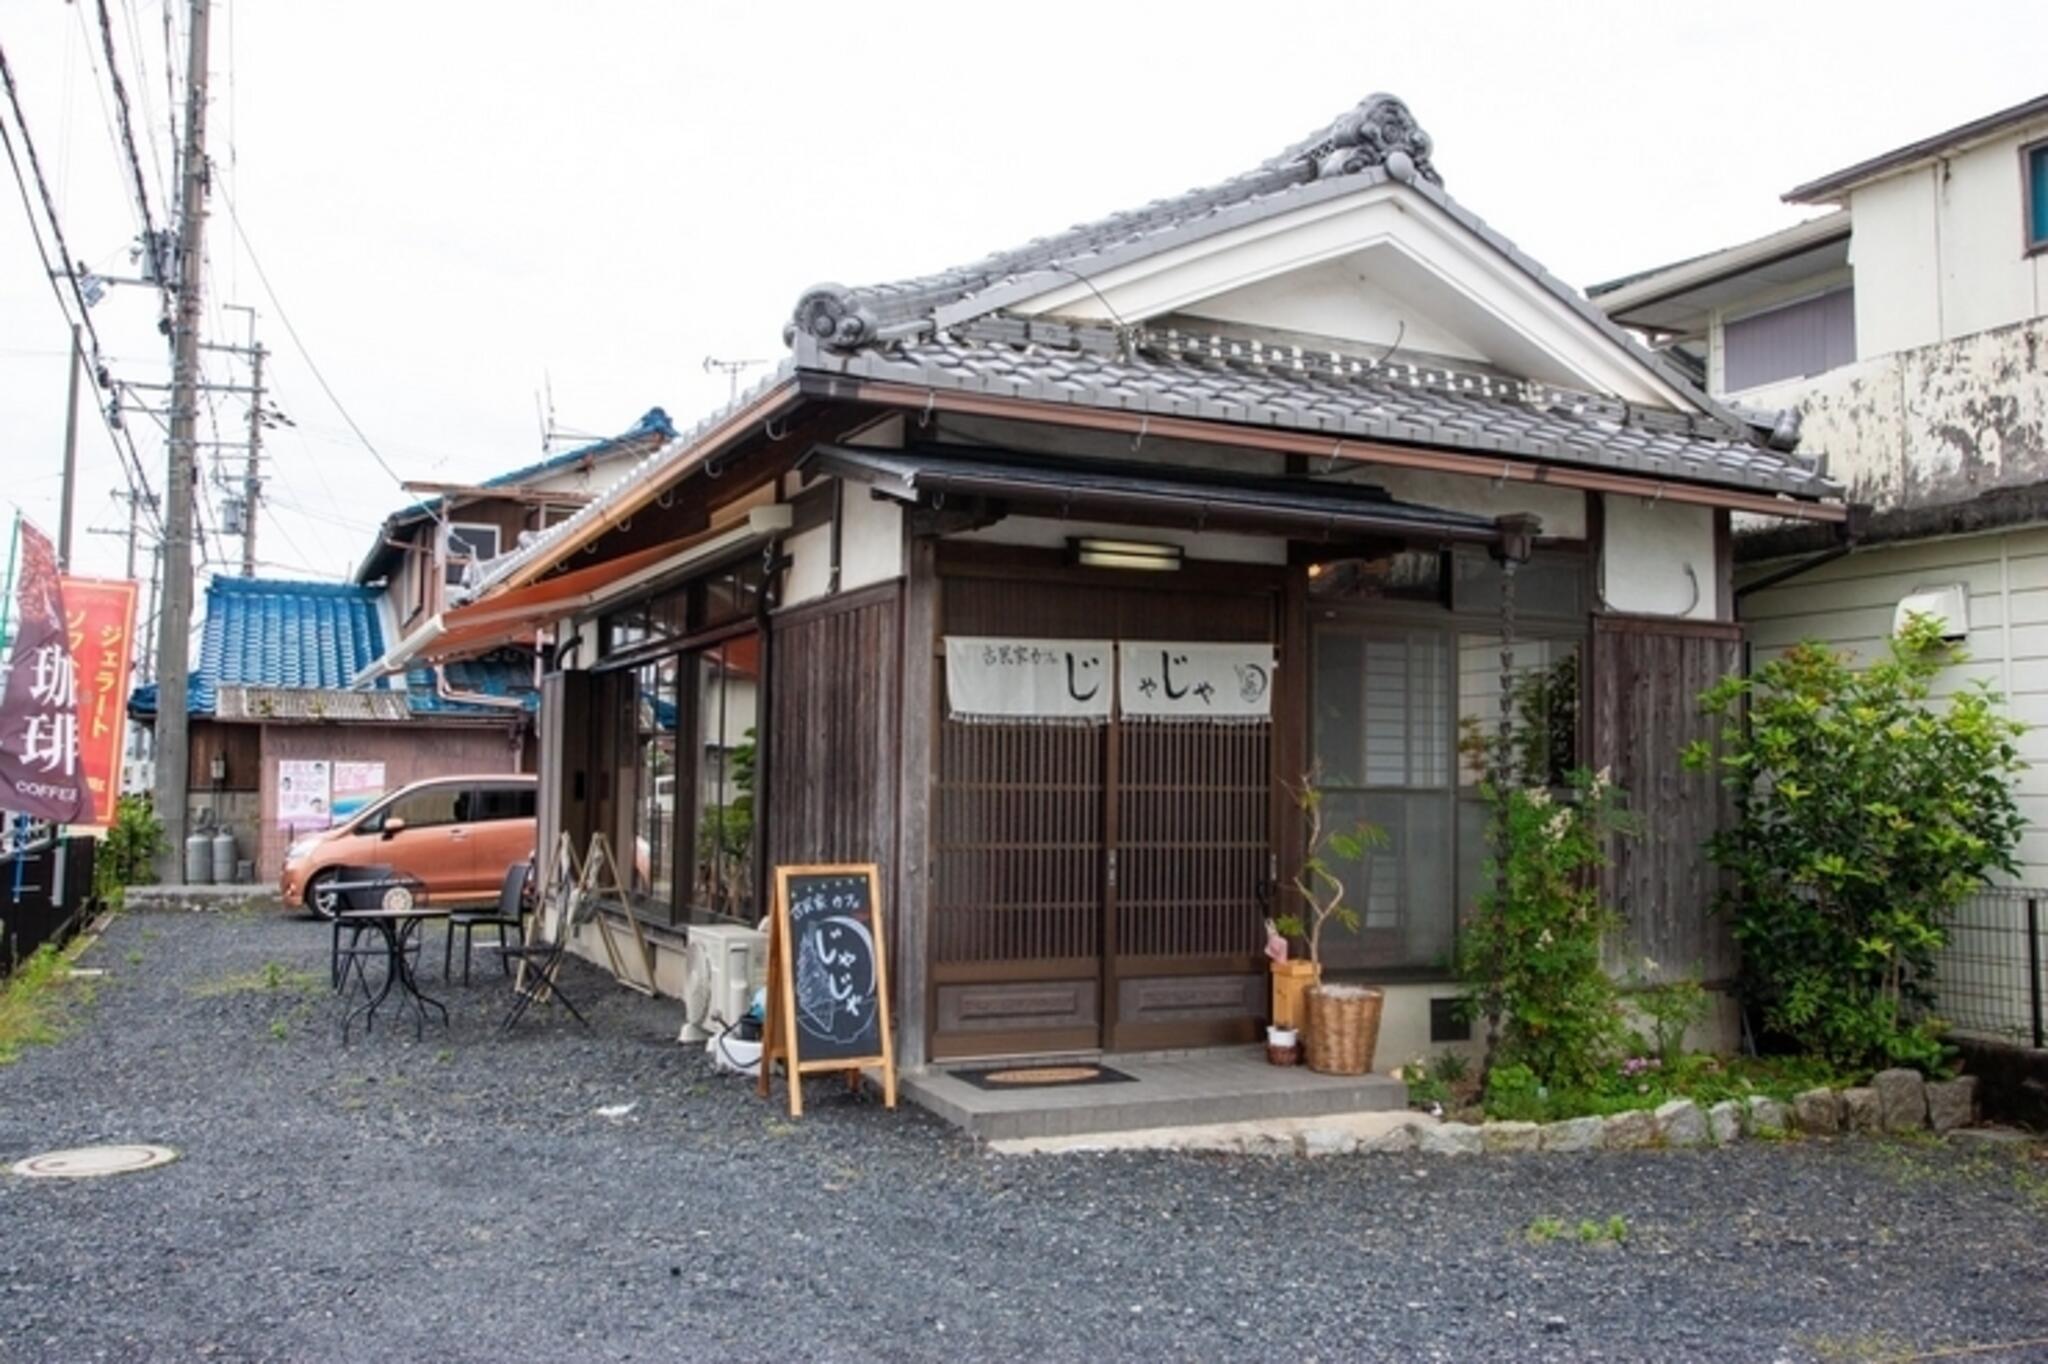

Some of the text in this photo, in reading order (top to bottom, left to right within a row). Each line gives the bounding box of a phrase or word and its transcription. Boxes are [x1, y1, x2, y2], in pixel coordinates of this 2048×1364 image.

[19, 643, 79, 777] 珈琲
[93, 624, 122, 738] ジェラート
